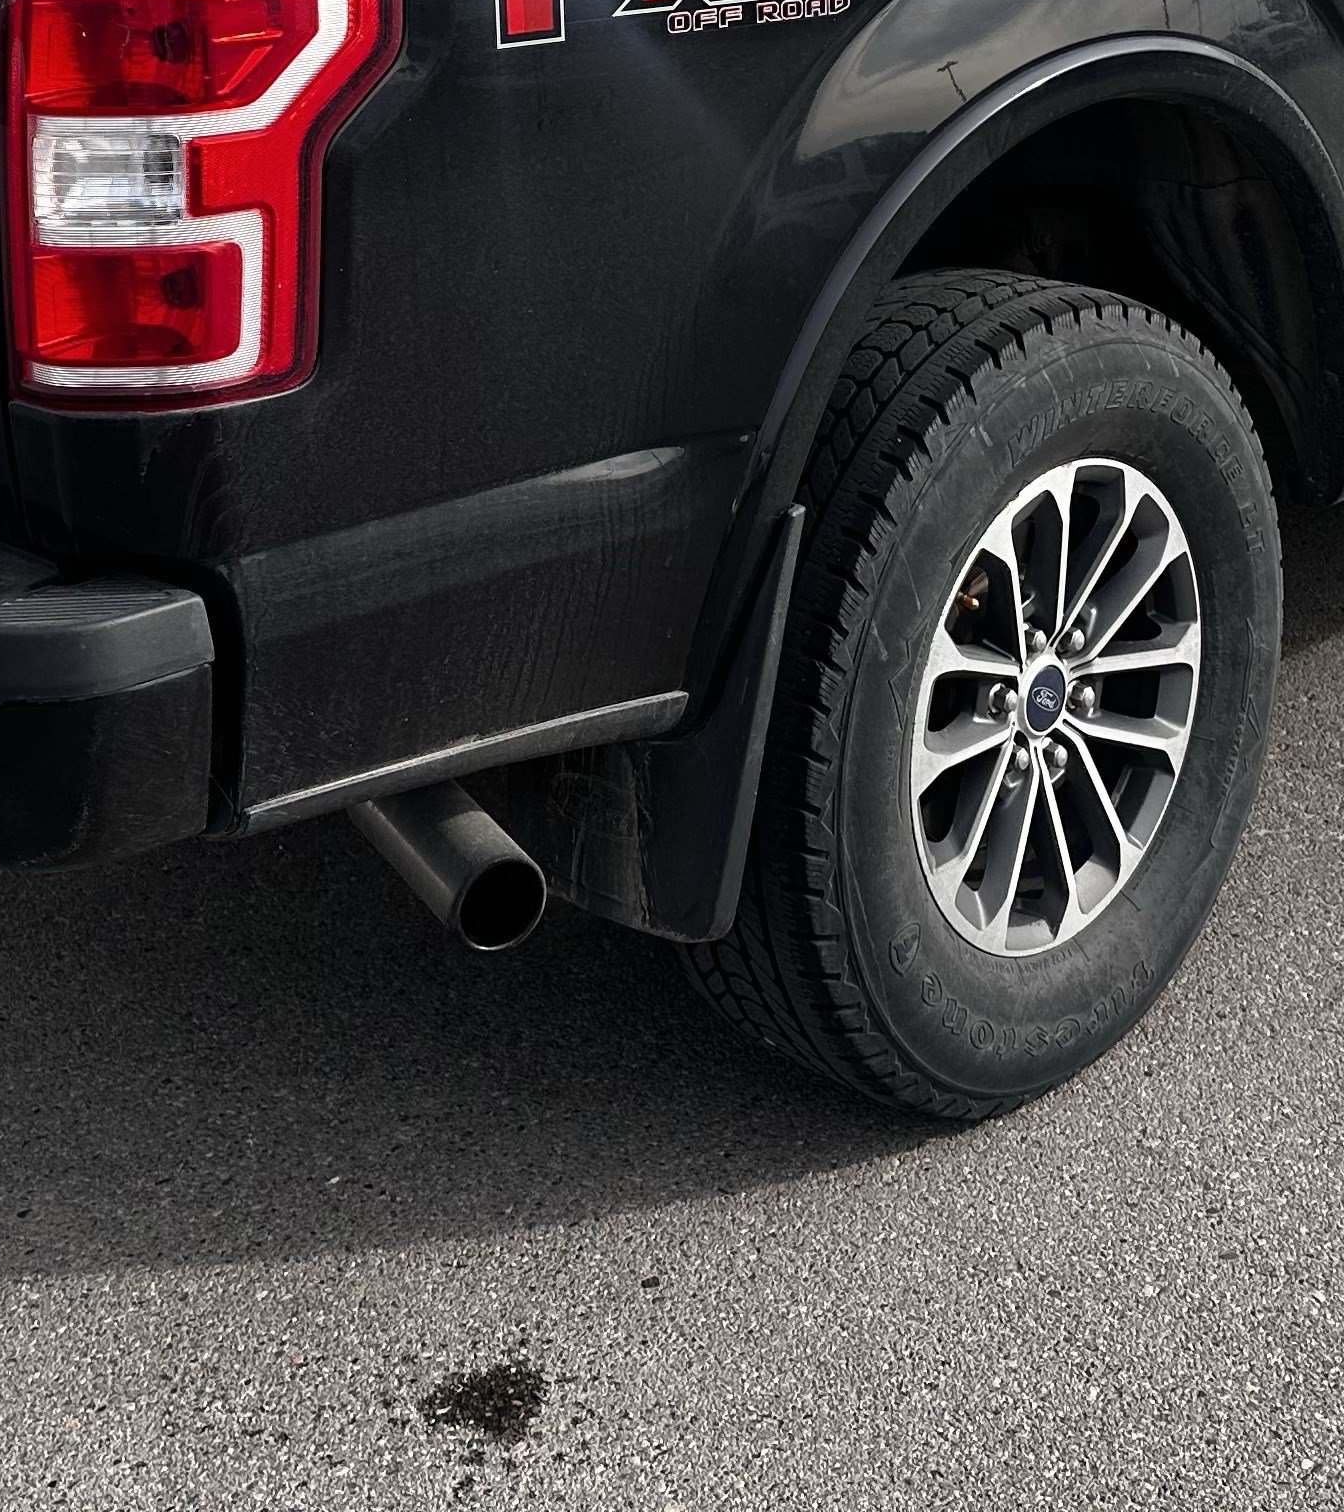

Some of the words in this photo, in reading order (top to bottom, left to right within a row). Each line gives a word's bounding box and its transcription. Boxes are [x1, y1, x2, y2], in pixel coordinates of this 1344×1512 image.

[666, 4, 743, 34] OFF
[1006, 379, 1247, 484] WINTERFORCE
[1036, 689, 1057, 709] Ford
[920, 958, 1156, 1061] Firestone
